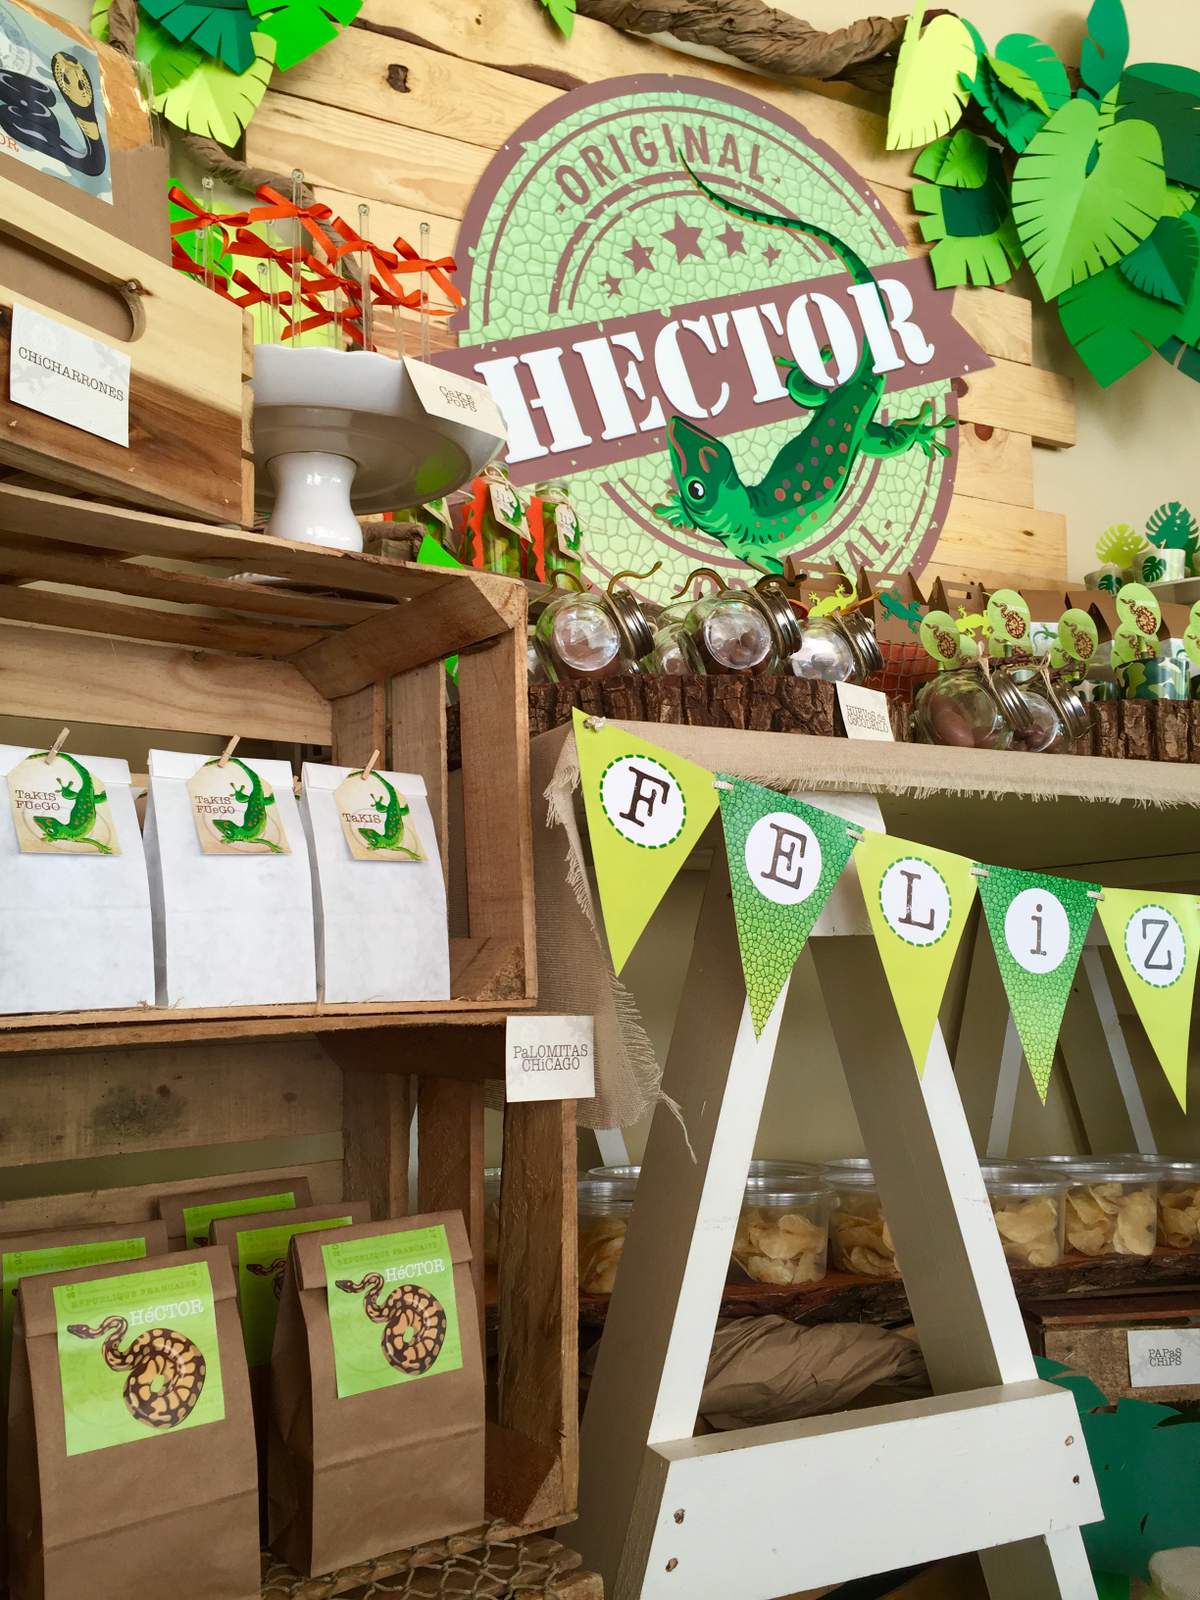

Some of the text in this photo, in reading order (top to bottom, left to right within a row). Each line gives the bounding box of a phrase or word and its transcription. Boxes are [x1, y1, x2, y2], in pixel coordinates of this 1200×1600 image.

[555, 123, 764, 205] ORIGINAL
[18, 346, 124, 401] CHiCHARRONES
[474, 279, 935, 464] HECTOR
[513, 1044, 588, 1059] PaLOMITAS
[522, 1057, 581, 1072] CHiCAGO
[129, 1298, 204, 1327] HéCTOR
